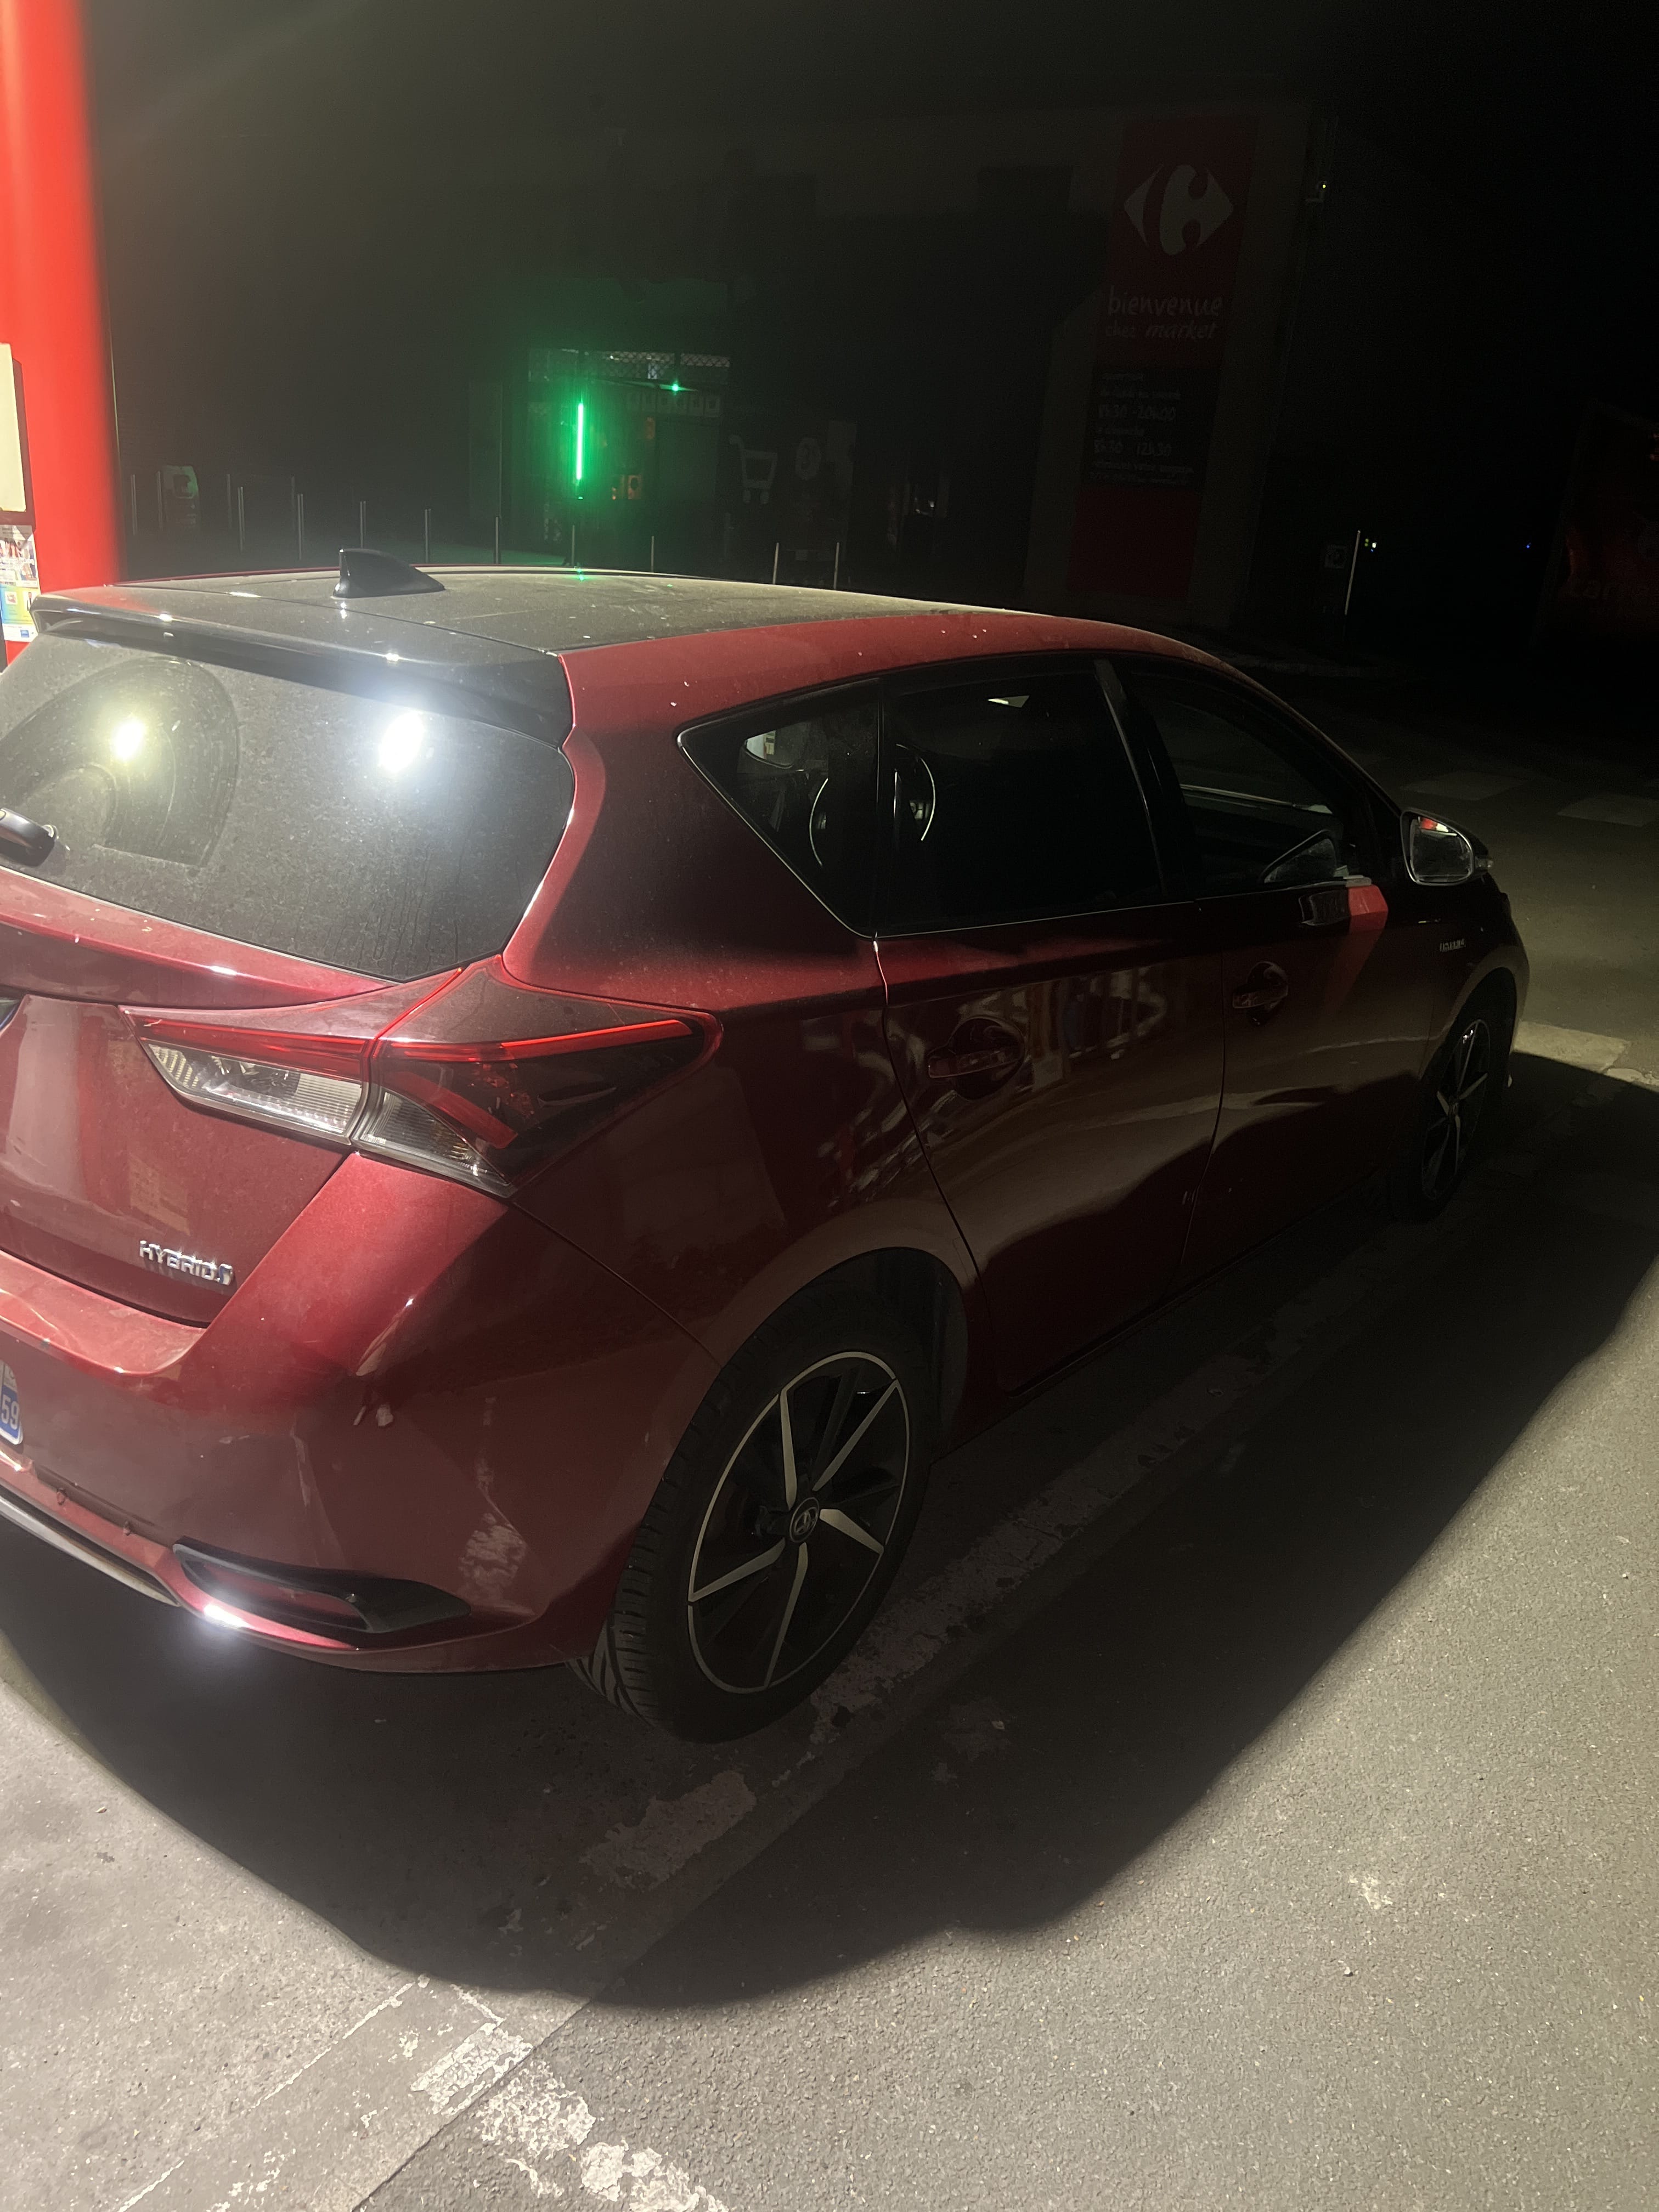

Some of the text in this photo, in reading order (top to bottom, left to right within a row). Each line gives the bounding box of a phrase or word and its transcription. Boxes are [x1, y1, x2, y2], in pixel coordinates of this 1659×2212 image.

[1107, 285, 1223, 317] bienvenue
[1144, 320, 1220, 341] market
[1, 1394, 20, 1430] 59
